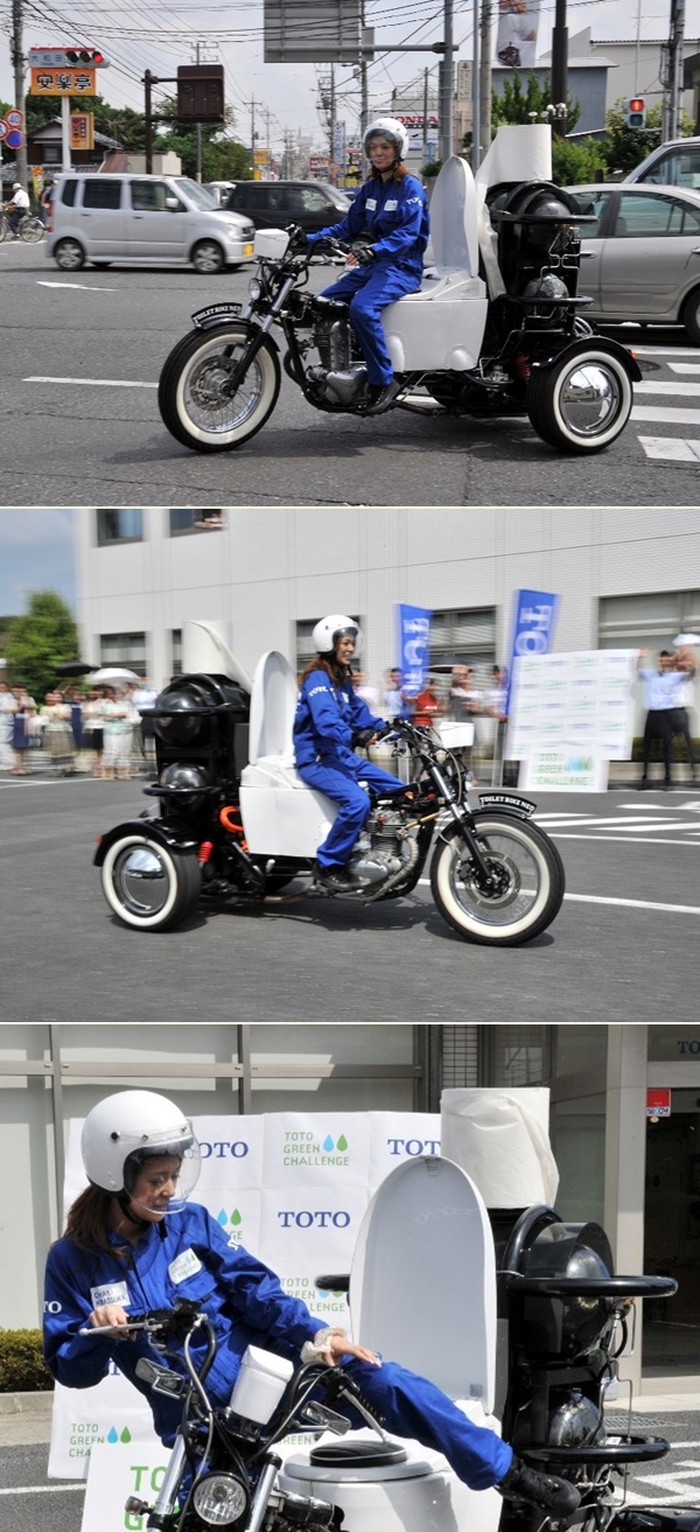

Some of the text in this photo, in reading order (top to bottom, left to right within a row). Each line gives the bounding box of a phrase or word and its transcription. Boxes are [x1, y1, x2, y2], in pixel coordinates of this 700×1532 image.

[392, 116, 439, 124] ONDA
[284, 1132, 313, 1141] TOTO
[198, 1141, 249, 1158] OTO
[284, 1144, 320, 1153] GREEN
[387, 1139, 442, 1156] TOT
[283, 1157, 349, 1166] CHALLENGE
[278, 1211, 351, 1228] TOTO
[286, 1290, 316, 1299] REEN
[310, 1303, 345, 1312] LENGE
[71, 1423, 99, 1433] TOTO
[282, 1435, 312, 1445] REEN
